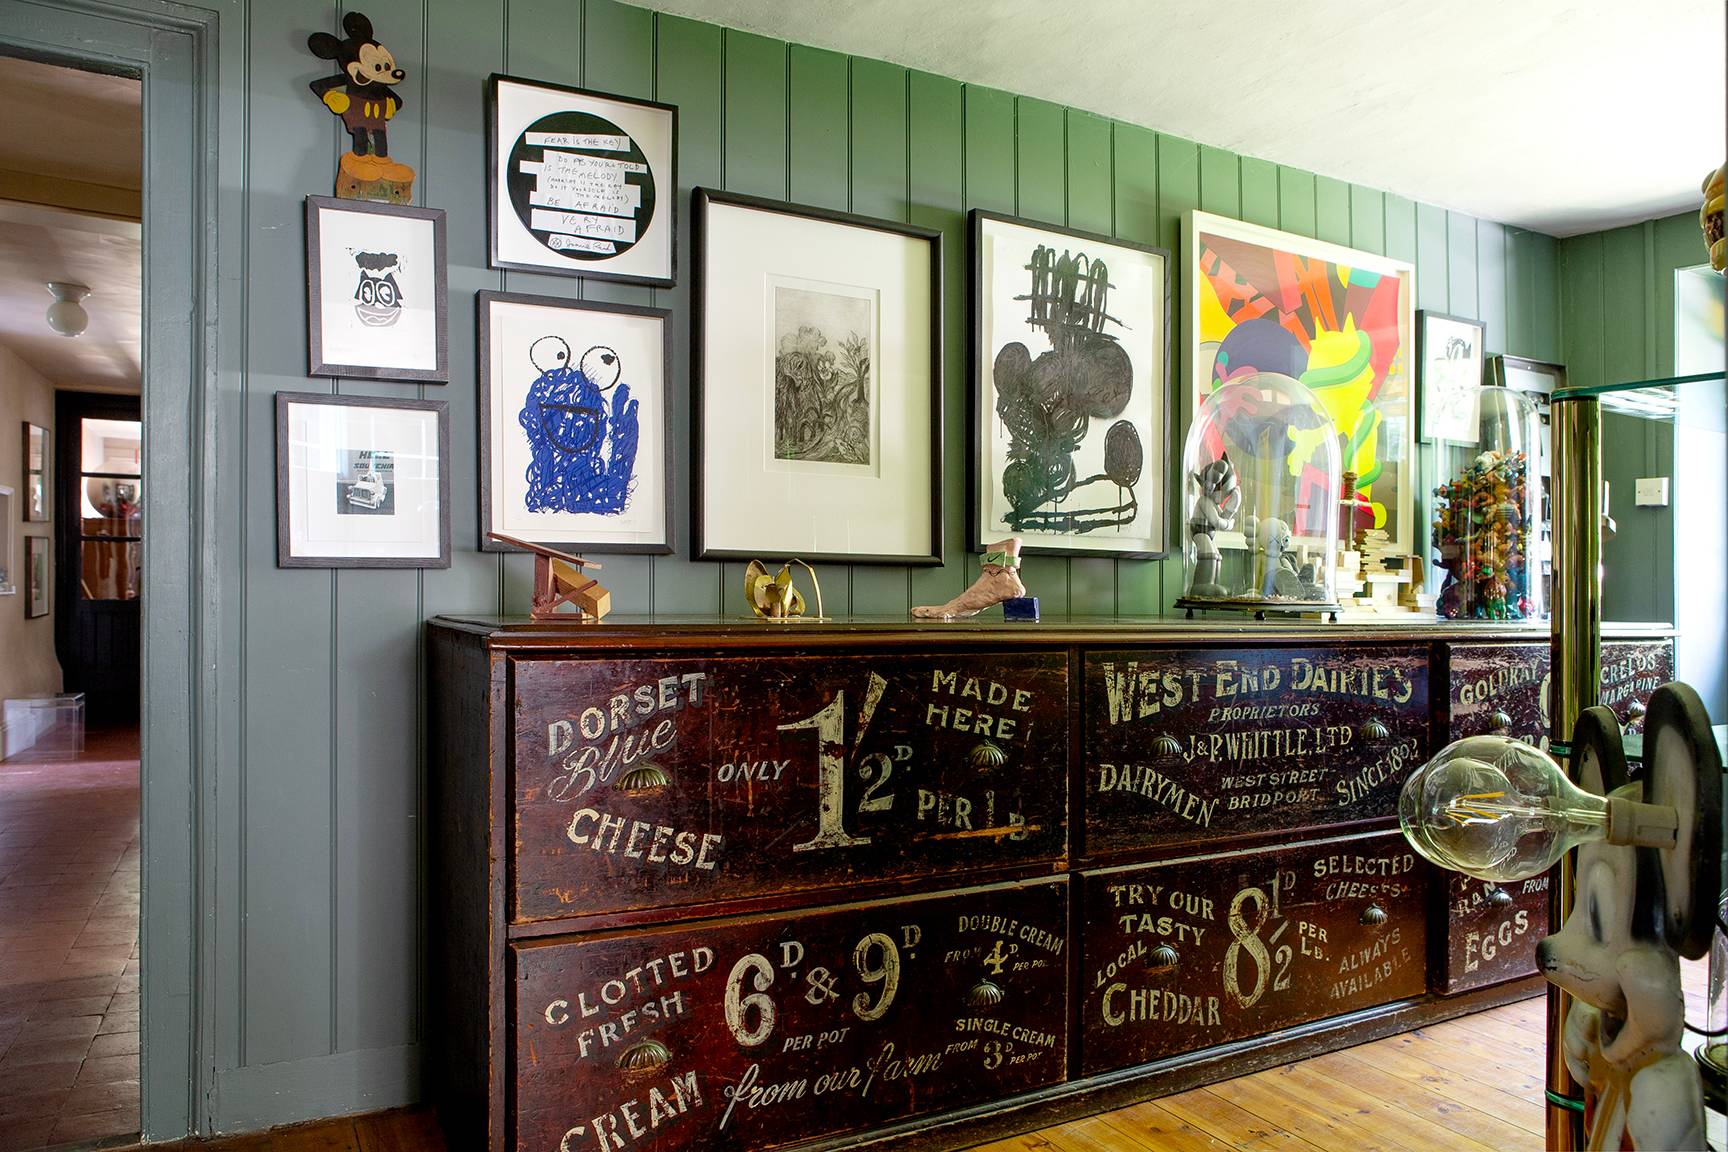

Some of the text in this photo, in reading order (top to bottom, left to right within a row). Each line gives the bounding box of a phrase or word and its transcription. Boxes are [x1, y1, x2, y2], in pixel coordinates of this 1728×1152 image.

[543, 136, 569, 145] FEAR
[584, 138, 599, 146] THE
[603, 138, 621, 151] KEY
[558, 166, 577, 175] THE
[579, 172, 617, 181] MELODY
[617, 162, 640, 170] TOLD
[547, 197, 619, 214] BE AFRAID
[562, 215, 598, 225] VERY
[575, 225, 625, 235] AFRAID
[932, 669, 1032, 712] MADE
[1102, 657, 1413, 725] WEST END DAIRIES
[548, 672, 706, 757] DORSET
[926, 703, 1017, 740] HERE
[1208, 702, 1320, 723] PROPRIETORS
[547, 719, 677, 802] Blue
[717, 759, 791, 783] ONLY
[1099, 764, 1220, 828] DAIRYMEN
[1221, 769, 1328, 790] WEST STREET
[1336, 760, 1388, 807] SINCE
[1228, 789, 1320, 811] BRIDPORT
[565, 808, 723, 870] CHEESE
[1314, 854, 1414, 878] SELECTED
[1110, 885, 1214, 920] TRY OUR
[1522, 877, 1549, 894] FROM
[959, 915, 1064, 956] DOUBLE CREAM
[1119, 914, 1206, 946] TASTY
[1299, 921, 1328, 943] PER
[1465, 910, 1528, 973] EGGS
[1096, 940, 1147, 989] LOCAL
[1338, 928, 1400, 974] ALWAYS
[544, 946, 714, 1025] CLOTTED
[805, 966, 840, 1005] &
[1330, 948, 1411, 1000] AVAILABLE
[1102, 983, 1220, 1026] CHEDDAR
[576, 990, 684, 1058] FRESH
[782, 1027, 850, 1053] PER POT
[956, 1018, 1056, 1048] SINGLE CREAM
[945, 1039, 978, 1055] FROM
[719, 1042, 944, 1131] from our farm
[560, 1070, 703, 1152] CREAM
